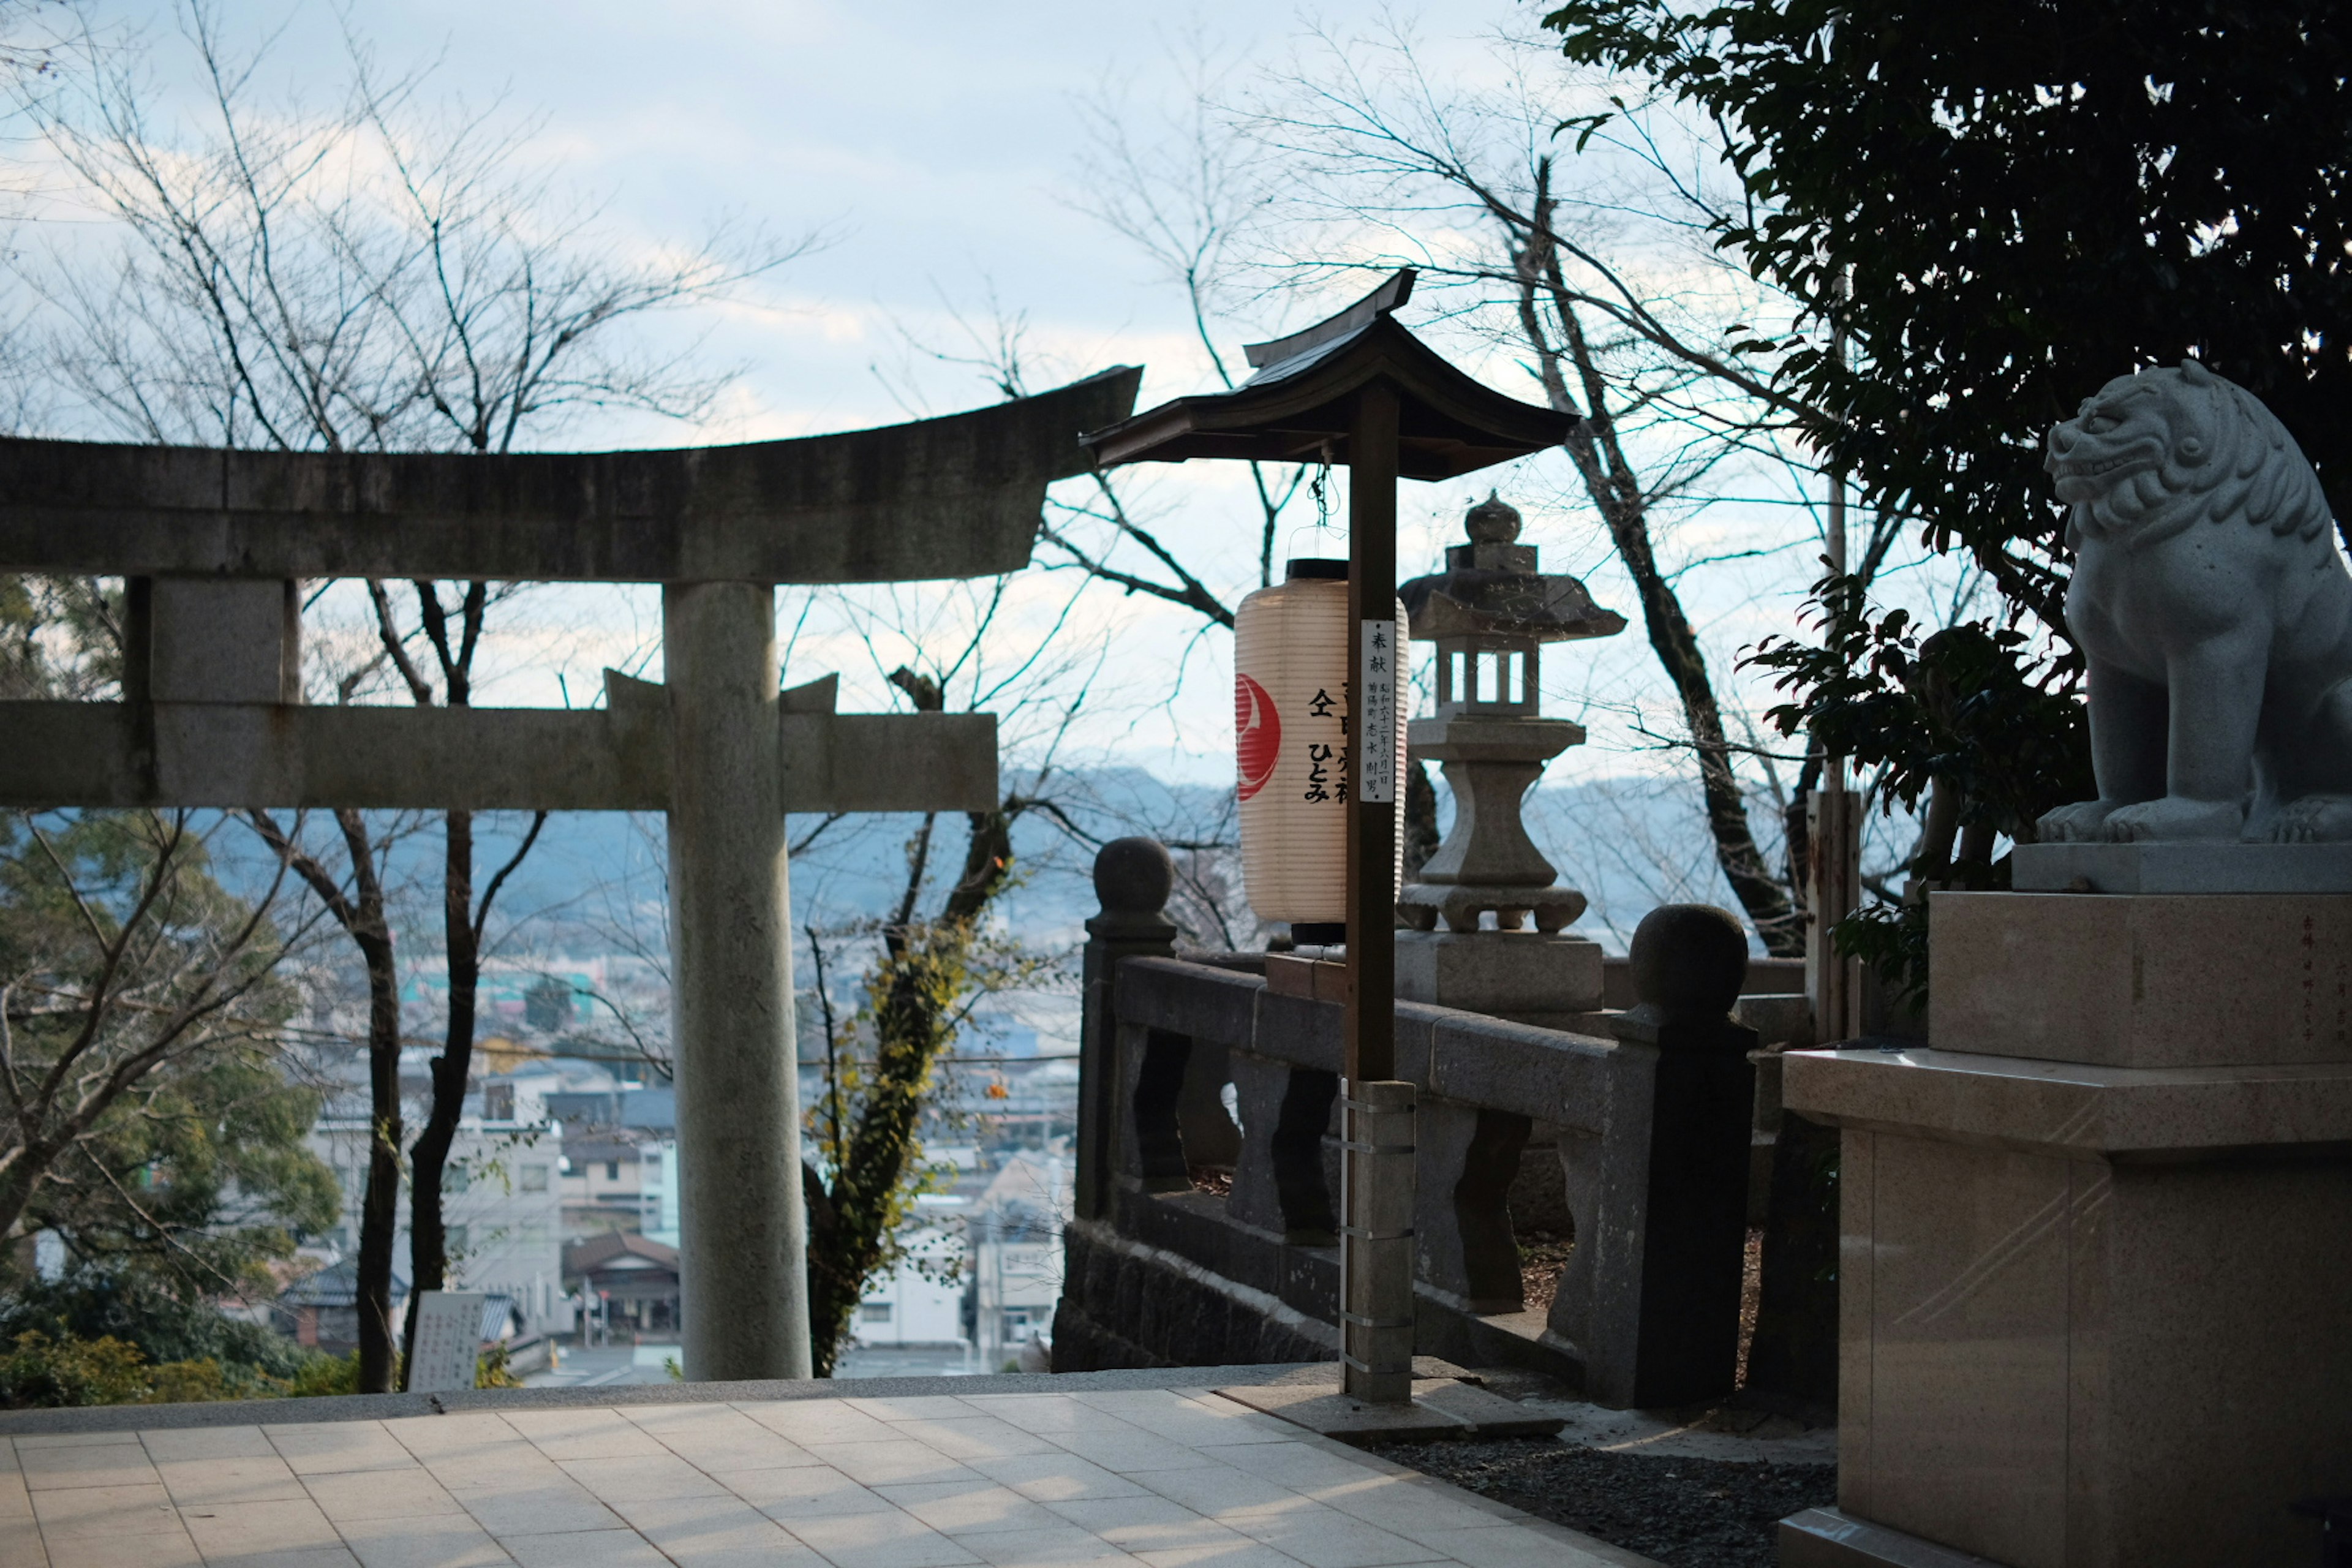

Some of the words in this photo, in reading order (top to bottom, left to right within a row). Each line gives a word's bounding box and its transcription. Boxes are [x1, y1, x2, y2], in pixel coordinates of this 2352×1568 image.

[1370, 632, 1387, 673] 奉献
[1379, 682, 1391, 785] 昭和六十二年六月一日
[1304, 744, 1333, 805] ひとみ
